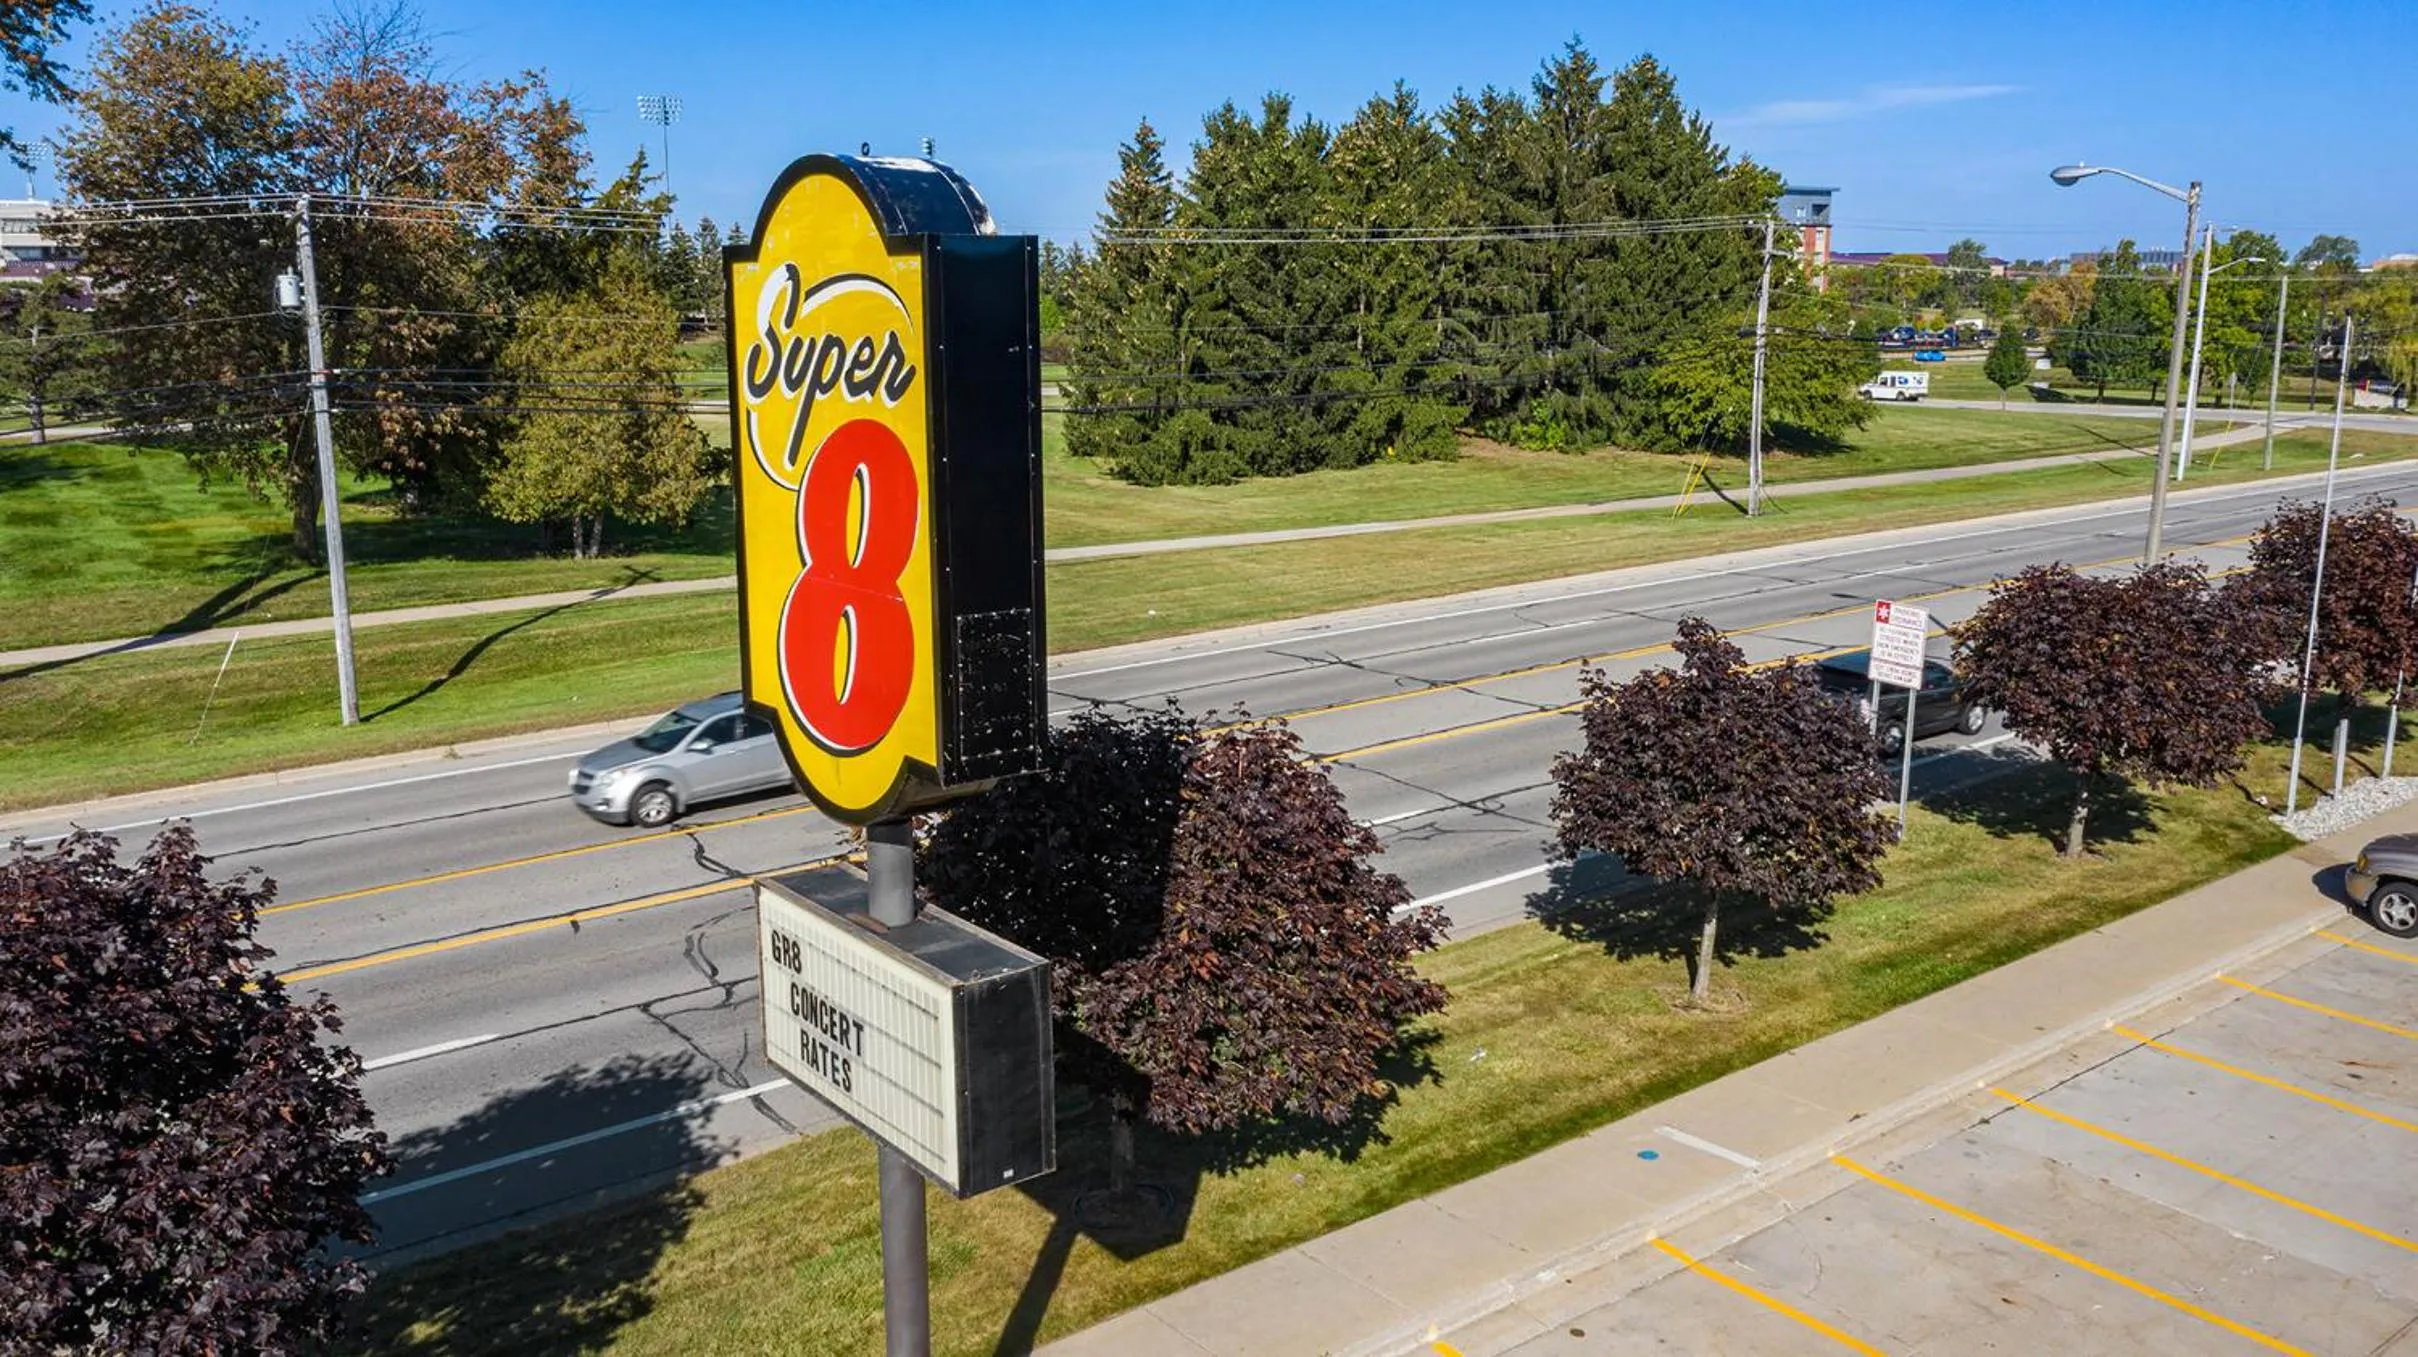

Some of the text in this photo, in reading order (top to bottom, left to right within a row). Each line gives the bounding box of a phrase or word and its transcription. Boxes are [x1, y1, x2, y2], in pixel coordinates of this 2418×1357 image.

[745, 261, 916, 470] Super
[778, 417, 919, 758] 8
[771, 930, 802, 974] GR8
[790, 982, 864, 1056] CONCERT
[800, 1029, 852, 1093] RATES
